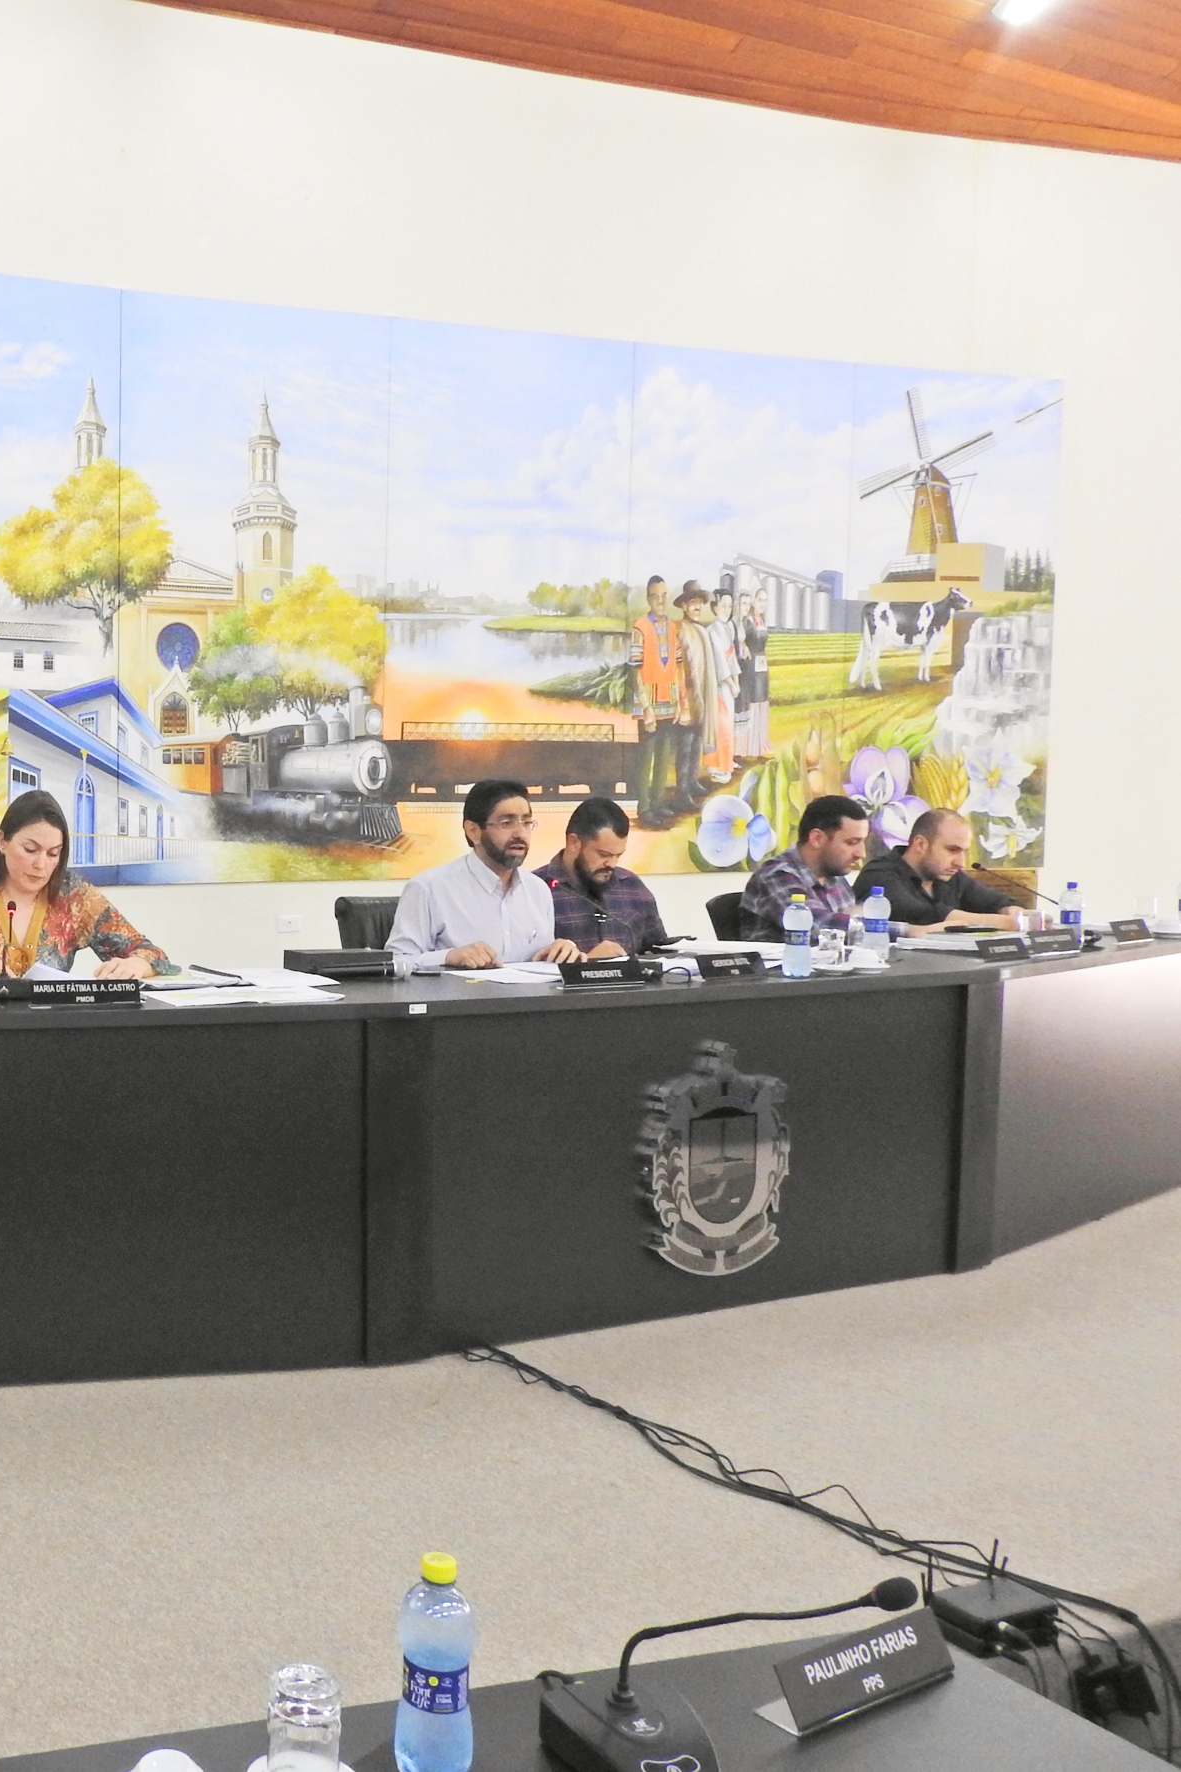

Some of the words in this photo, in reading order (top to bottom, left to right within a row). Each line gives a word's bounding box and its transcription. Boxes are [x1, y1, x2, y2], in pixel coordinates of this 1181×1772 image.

[581, 969, 623, 979] PRESIDENTE
[33, 984, 55, 993] MARIA
[56, 984, 65, 993] DE
[67, 982, 91, 993] FÁTIMA
[92, 984, 99, 992] B.
[100, 984, 107, 992] A.
[108, 983, 136, 992] CASTRO
[804, 1643, 872, 1685] PAULINHO
[869, 1625, 918, 1660] FARIAS
[862, 1673, 885, 1694] PPS
[411, 1692, 431, 1709] Life
